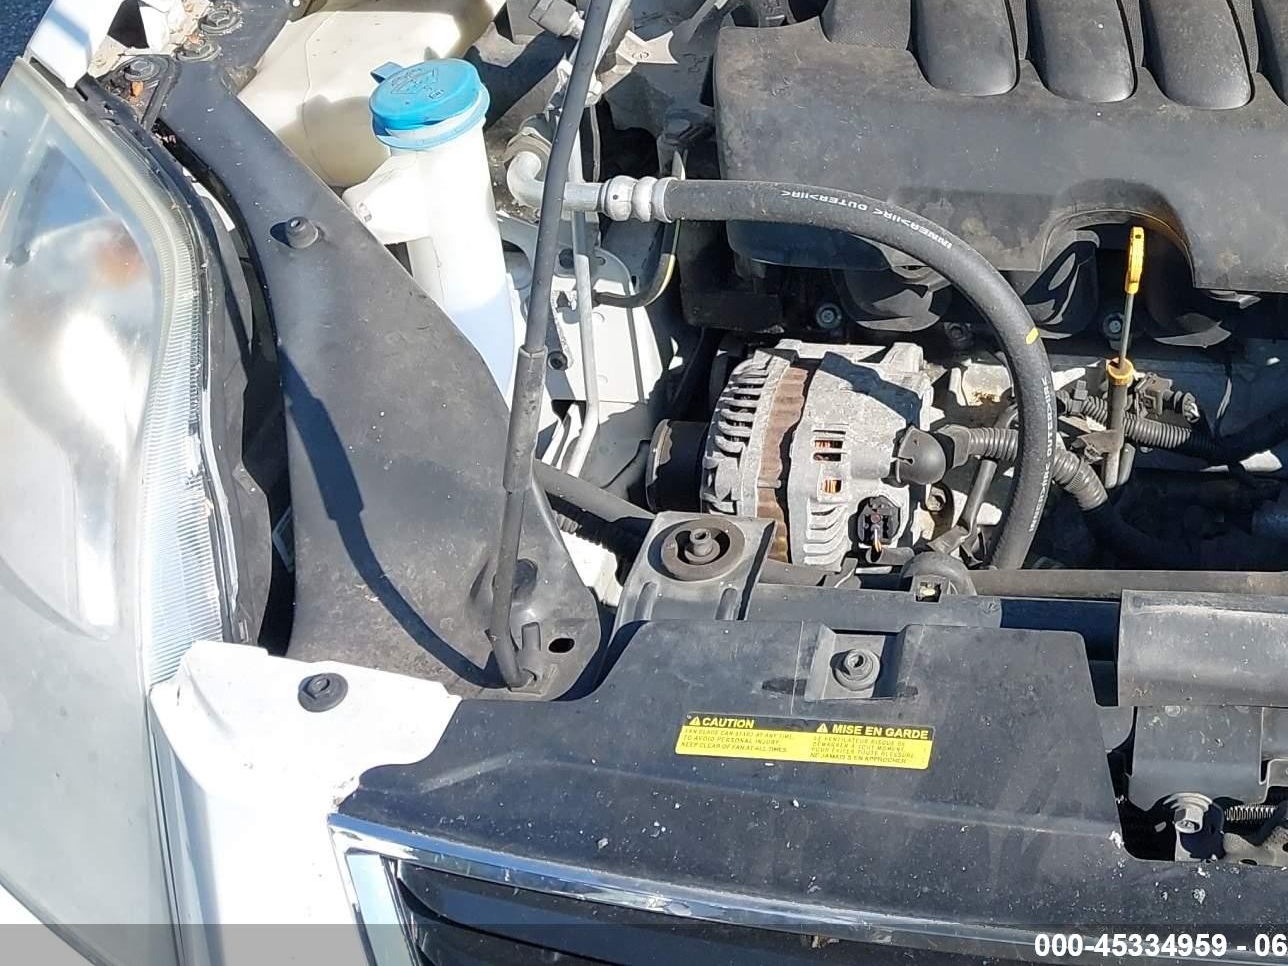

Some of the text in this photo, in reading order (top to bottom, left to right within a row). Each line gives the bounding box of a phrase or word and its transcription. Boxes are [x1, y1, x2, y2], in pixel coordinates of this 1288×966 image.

[702, 717, 755, 728] CAUTION
[832, 724, 928, 739] MISE EN GARDE
